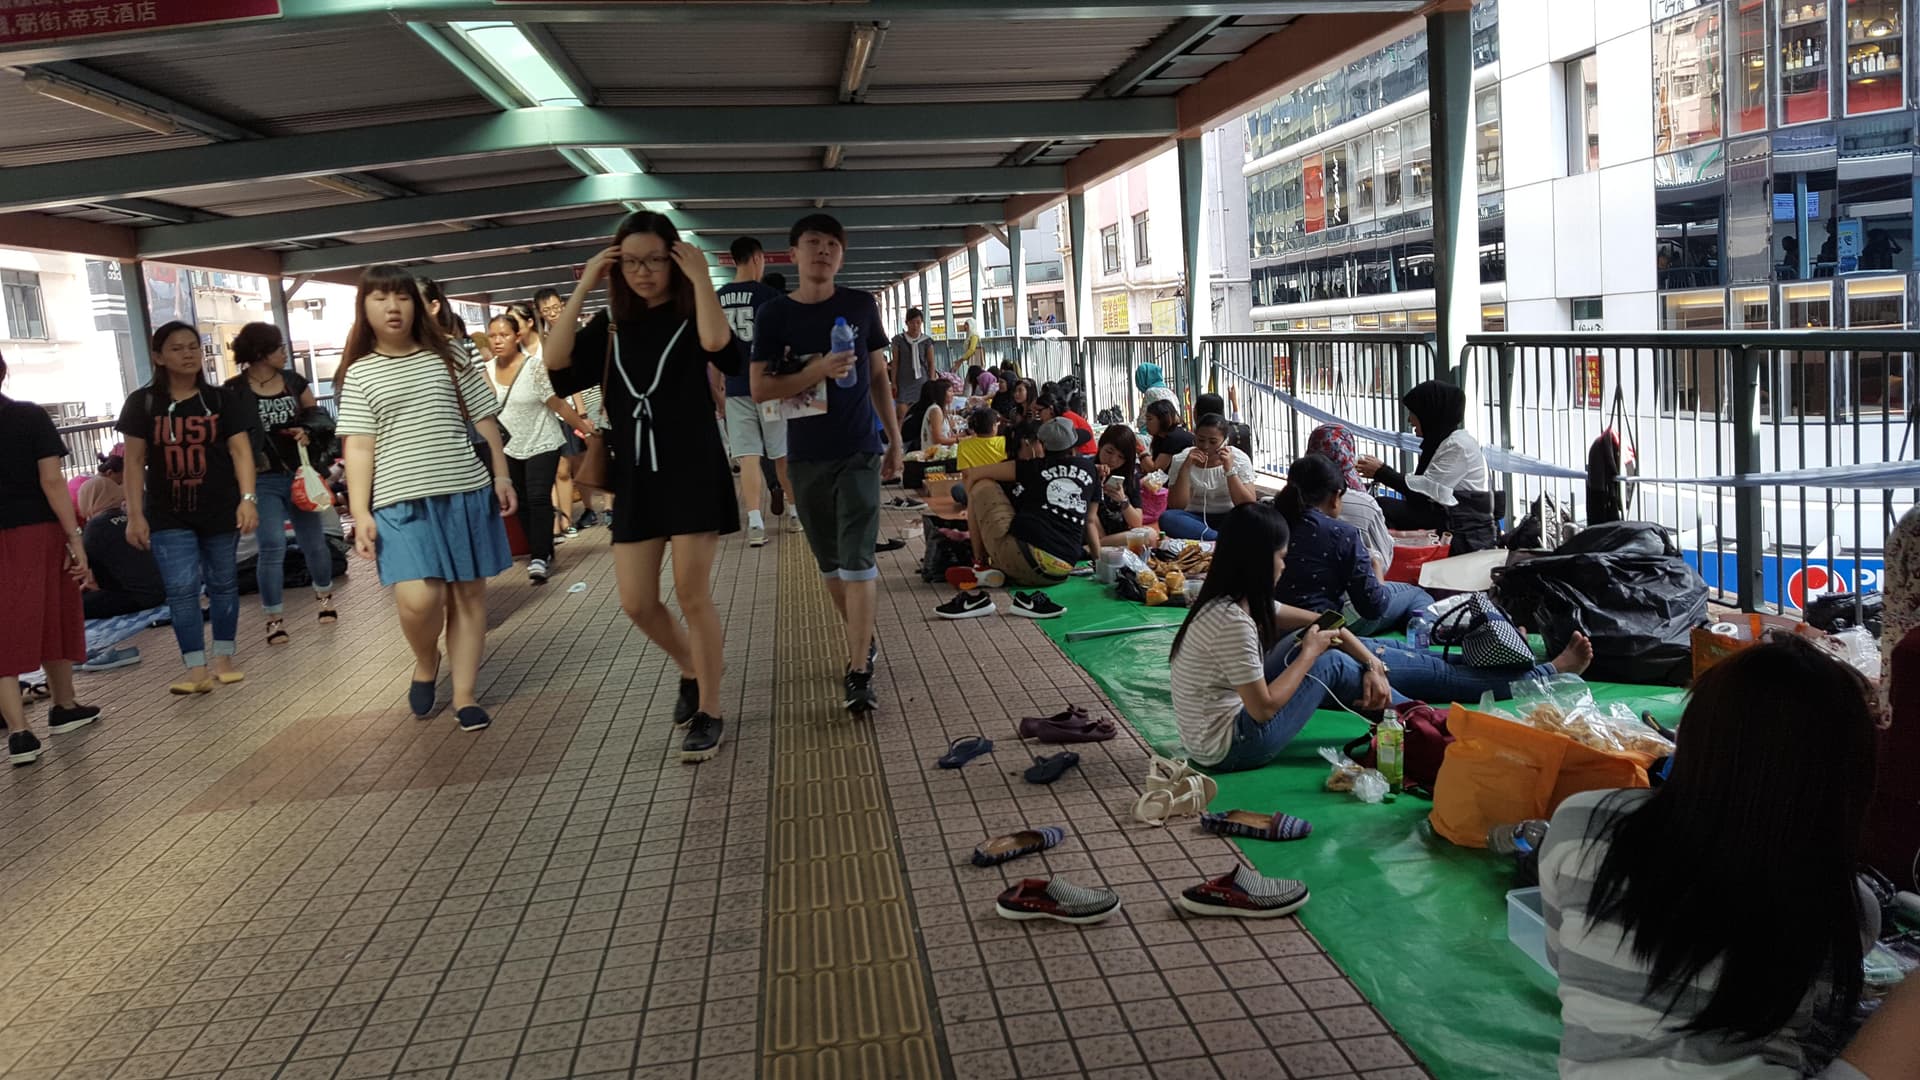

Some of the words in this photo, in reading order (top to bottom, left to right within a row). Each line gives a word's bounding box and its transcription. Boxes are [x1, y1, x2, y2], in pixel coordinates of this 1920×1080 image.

[1333, 184, 1341, 223] Pizza
[720, 291, 753, 306] DURANT
[154, 414, 219, 446] JUST
[164, 444, 207, 480] DO
[1041, 464, 1093, 486] STREET
